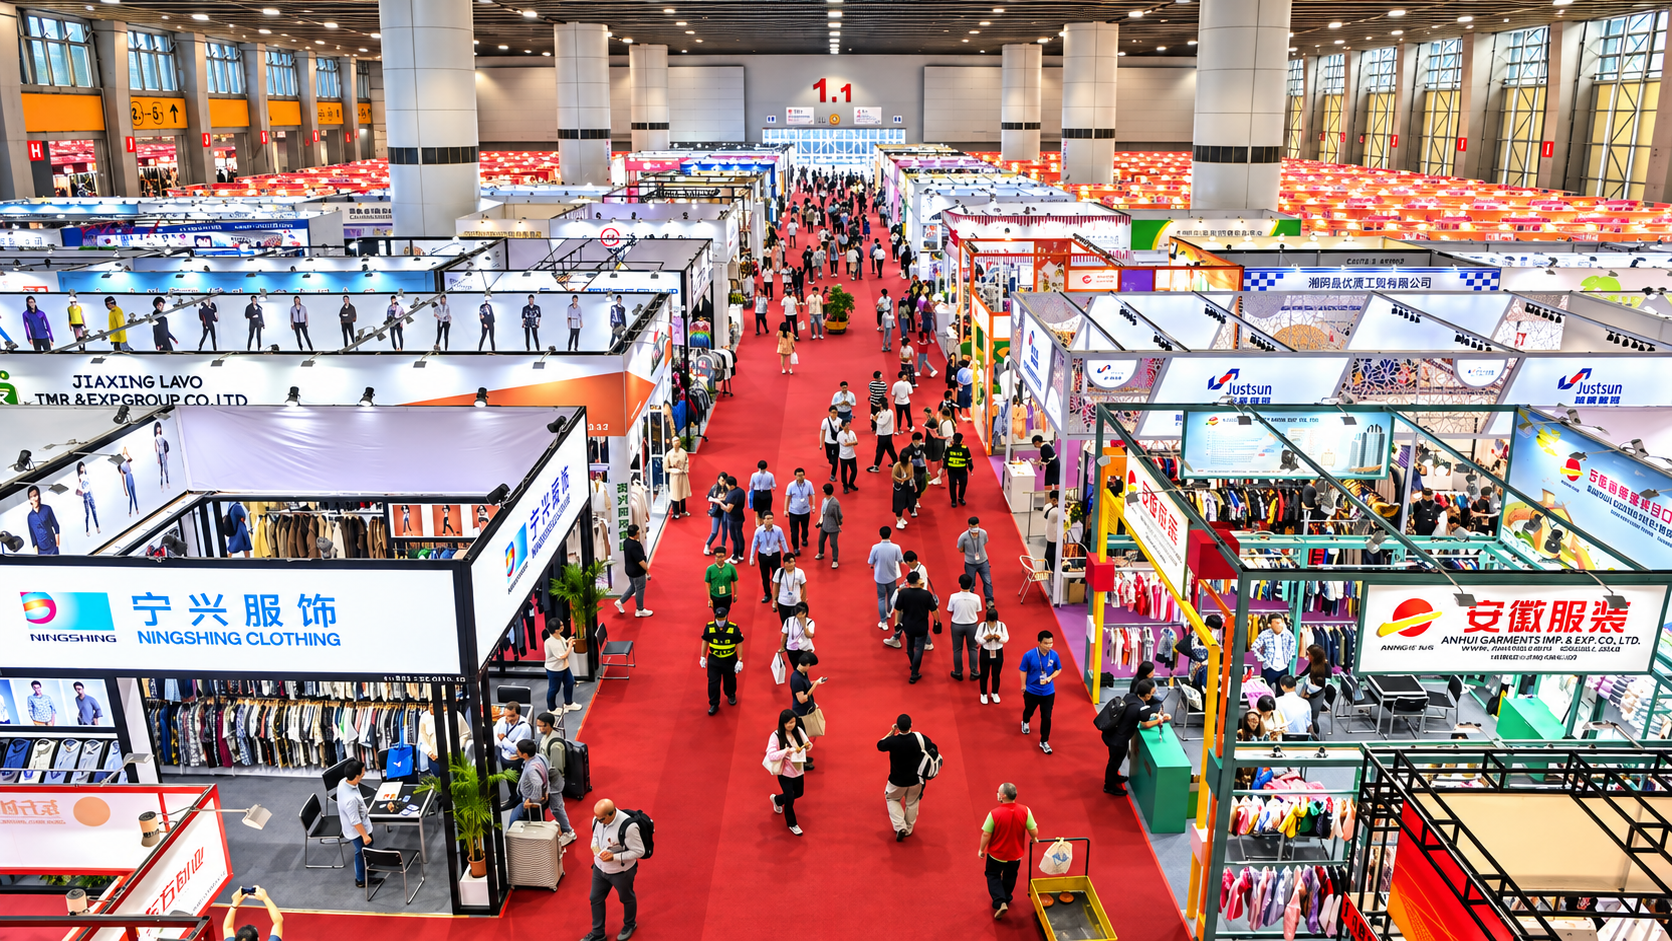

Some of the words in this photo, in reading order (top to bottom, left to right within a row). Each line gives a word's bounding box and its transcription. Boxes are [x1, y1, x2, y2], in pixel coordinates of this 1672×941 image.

[813, 78, 851, 103] 1.1
[31, 143, 42, 158] H
[72, 375, 154, 389] JIAXING
[160, 375, 203, 389] LAVO
[1226, 382, 1272, 395] Justsun
[1576, 381, 1623, 395] Justsun
[131, 592, 337, 628] 宁兴服饰
[1463, 600, 1631, 633] 安徽服装
[30, 634, 117, 643] NINGSHING
[137, 631, 242, 646] NINGSHING
[245, 632, 342, 646] CLOTHING
[1441, 636, 1478, 645] ANHUI
[1480, 636, 1541, 645] GARMENTS
[1542, 636, 1564, 645] IMP.
[1565, 636, 1573, 645] &
[1618, 636, 1641, 645] LTD.
